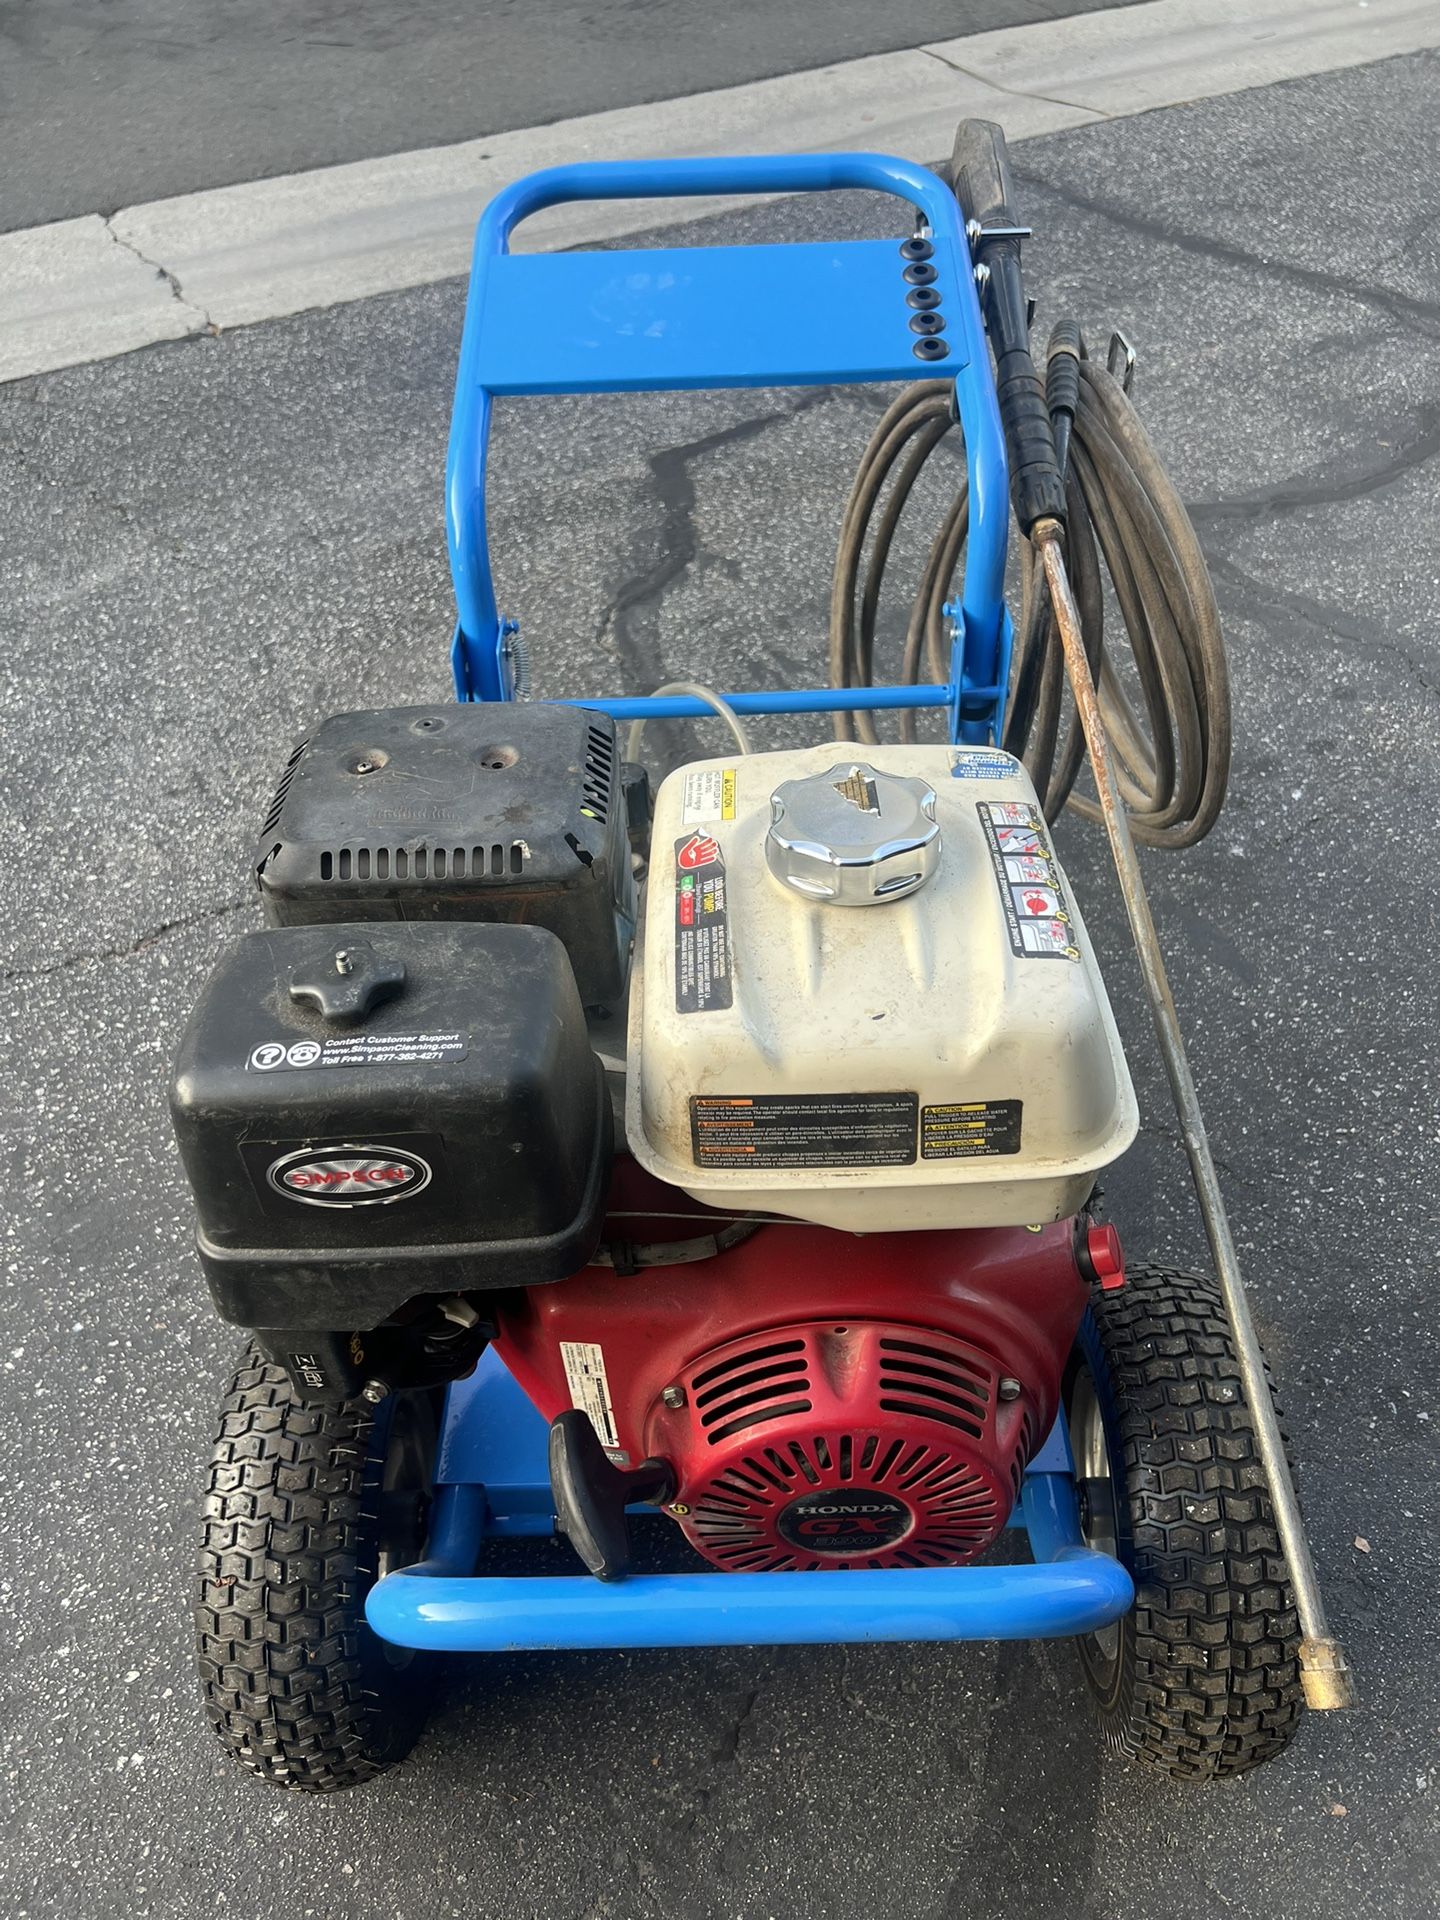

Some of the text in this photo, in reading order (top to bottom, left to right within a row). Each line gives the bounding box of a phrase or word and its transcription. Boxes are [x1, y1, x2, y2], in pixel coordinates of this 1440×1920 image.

[986, 828, 998, 850] ENCENDIDO
[994, 854, 1004, 871] MOTEUR
[704, 880, 714, 913] YOU PUMP!
[715, 877, 724, 911] LOOK BEFORE
[1008, 912, 1018, 927] START
[1012, 928, 1021, 946] ENGINE
[323, 1042, 463, 1055] www.SimpsonCleaning.com
[325, 1034, 459, 1046] Contact Customer Support
[322, 1052, 444, 1065] Toll Free 1-877-362-4271
[292, 1168, 406, 1186] SIMPSON
[795, 1504, 901, 1514] HONDA
[798, 1516, 896, 1535] GX
